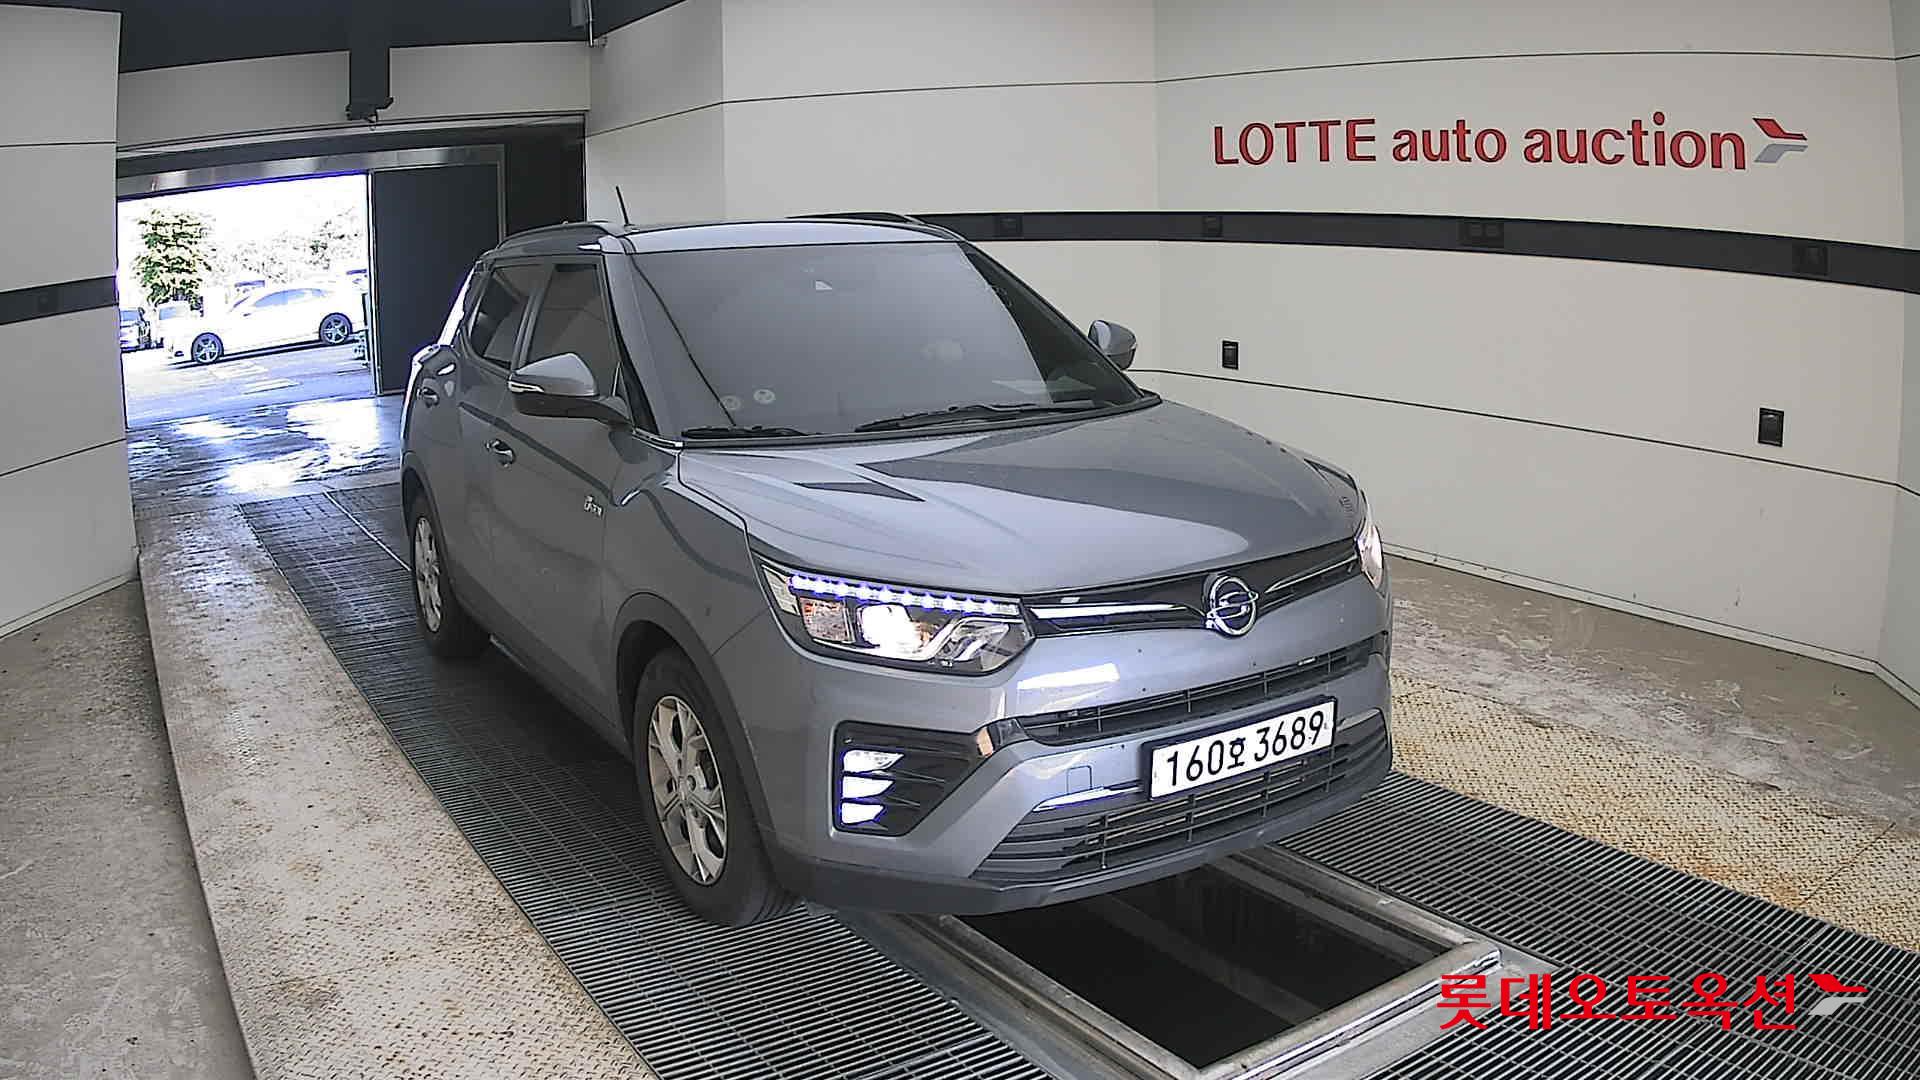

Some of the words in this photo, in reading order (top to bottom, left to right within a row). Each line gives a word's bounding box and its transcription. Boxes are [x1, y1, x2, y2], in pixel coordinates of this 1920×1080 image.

[1213, 118, 1377, 165] LOTTE
[1392, 119, 1508, 163] auto
[1523, 111, 1747, 170] auction
[1254, 710, 1324, 762] 3689
